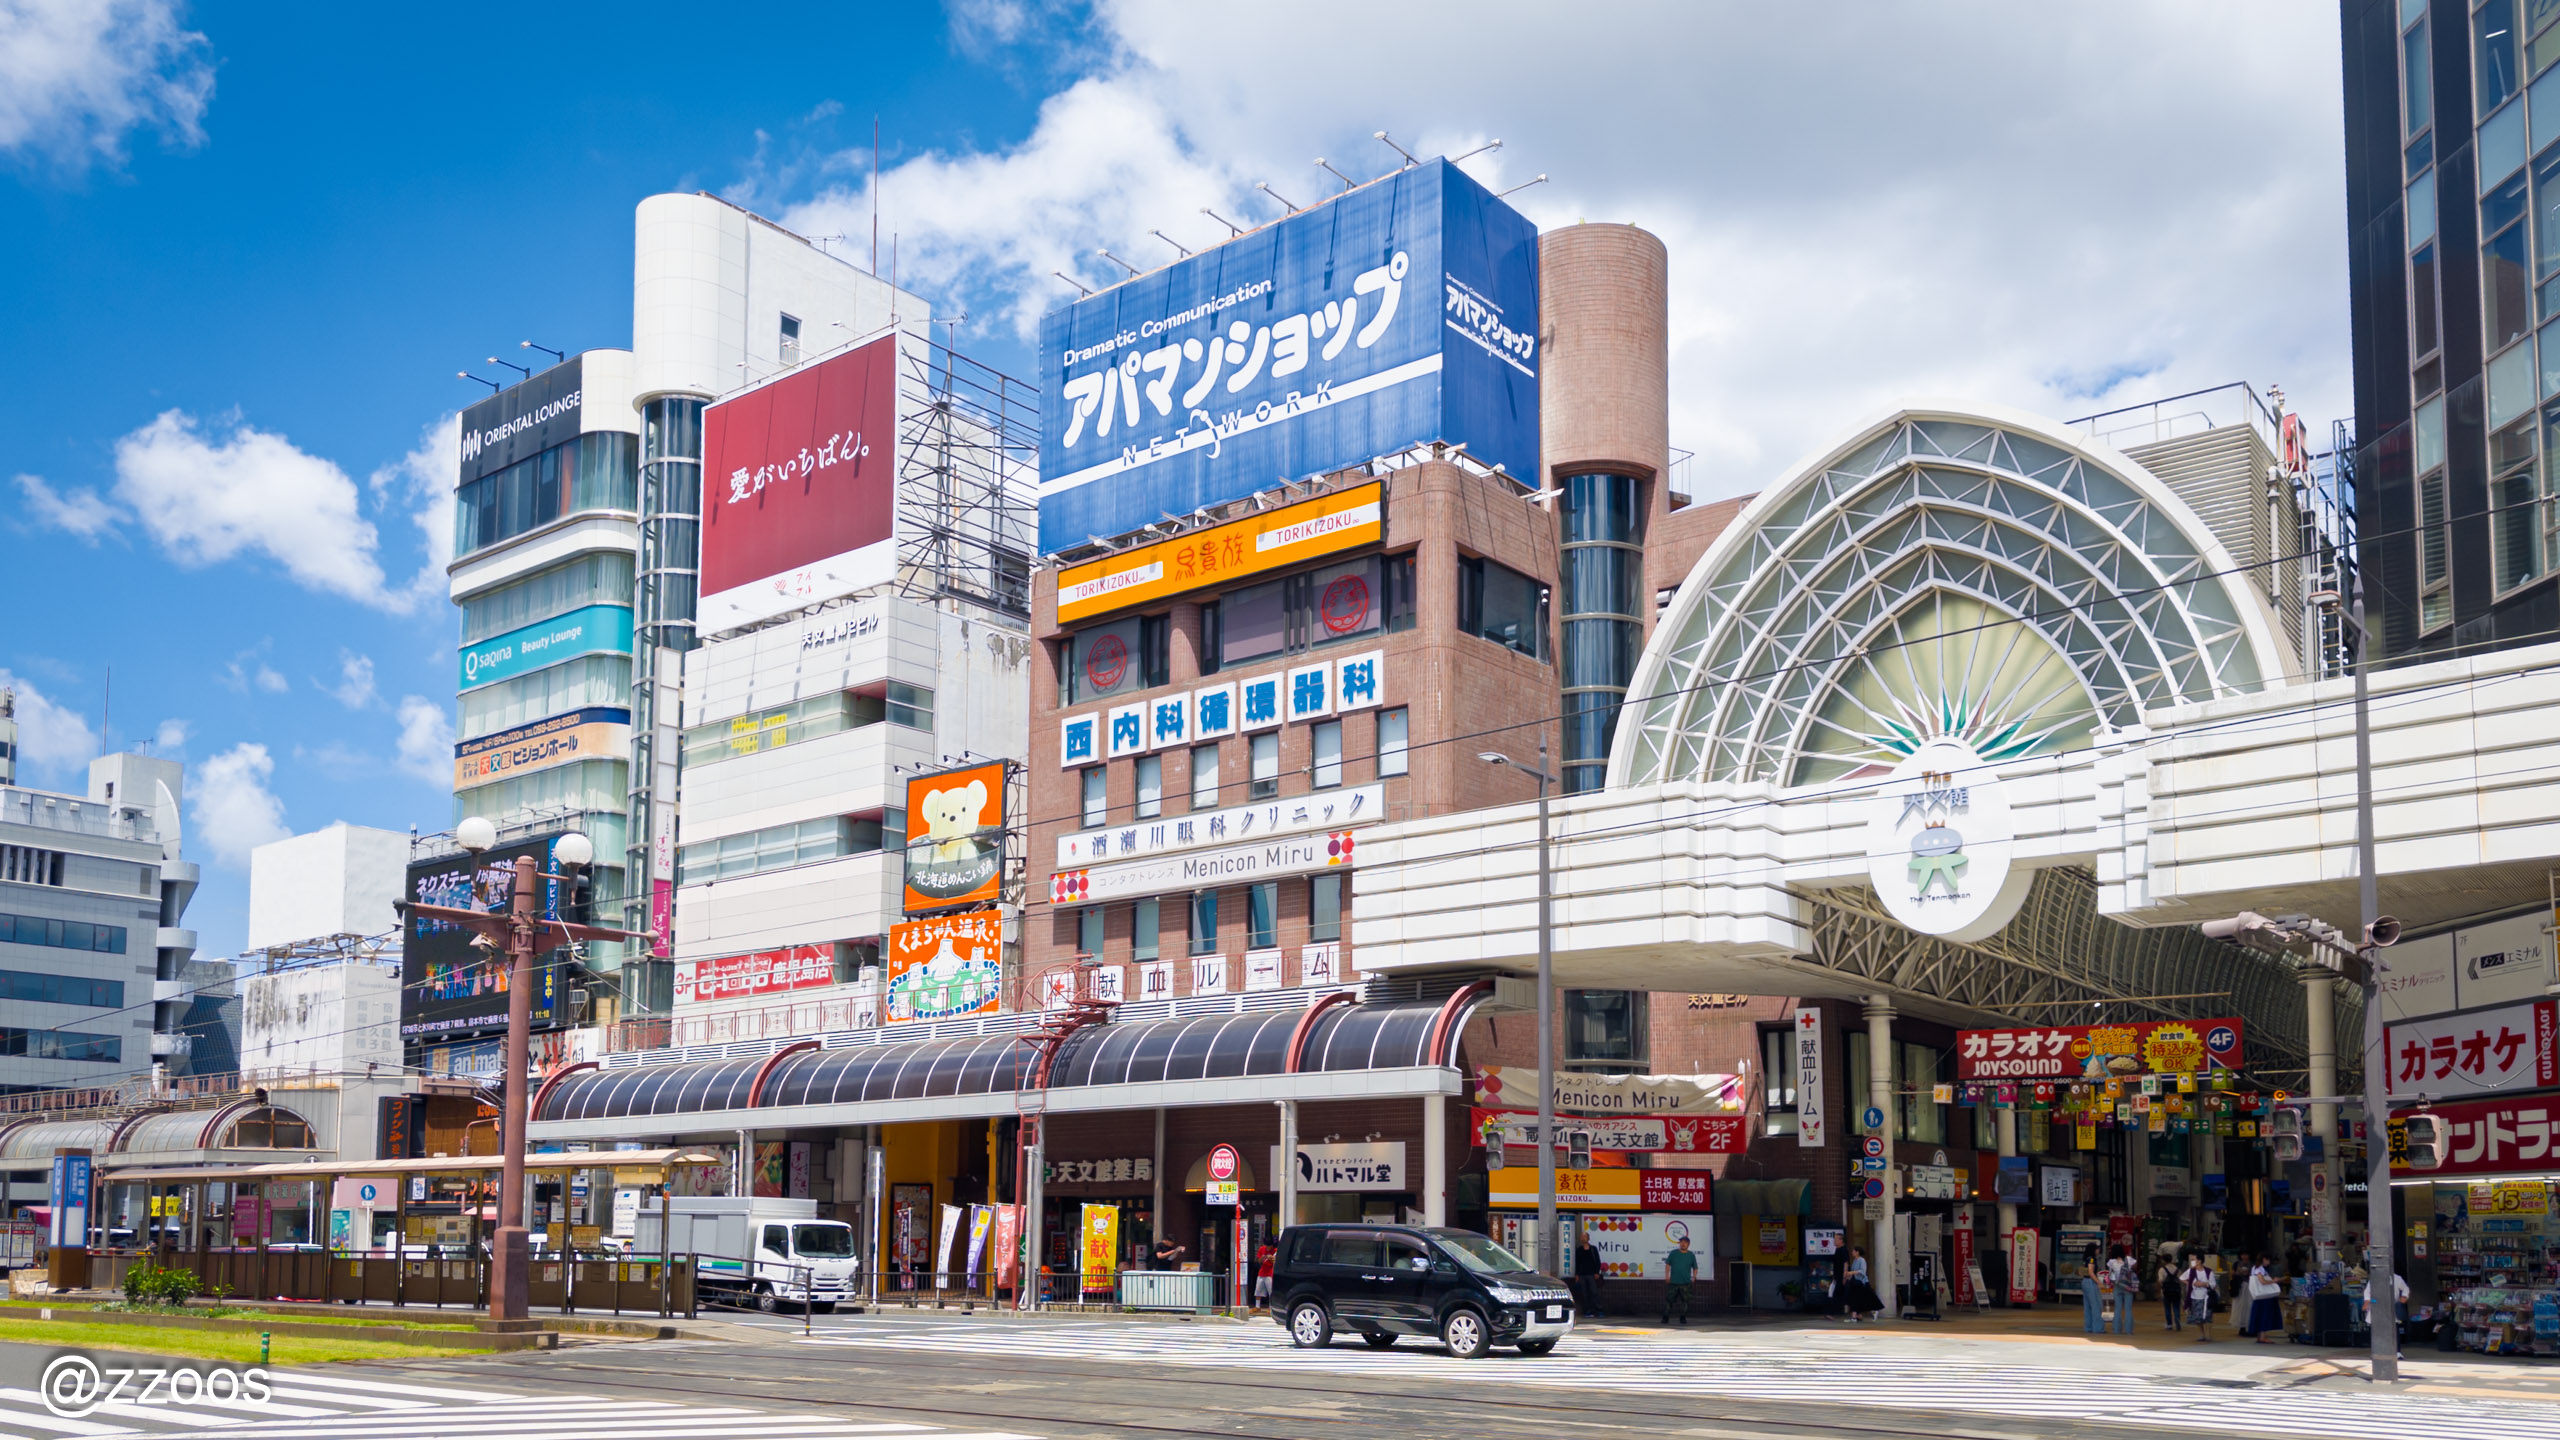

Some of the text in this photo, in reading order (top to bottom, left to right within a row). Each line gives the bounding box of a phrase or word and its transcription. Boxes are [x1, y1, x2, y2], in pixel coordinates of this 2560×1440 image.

[1063, 279, 1273, 367] Dramatic Communication
[1445, 284, 1535, 360] アパマンショップ
[1062, 250, 1409, 449] アパマンショップ
[484, 390, 581, 447] ORIENTAL LOUNGE
[1122, 378, 1333, 468] NETWORK
[727, 429, 871, 505] 愛がいちばん。
[1276, 511, 1353, 545] TORIKIZOKU
[1075, 571, 1139, 599] TORIKIZOKU
[521, 625, 582, 654] Beauty Lounge
[1066, 658, 1376, 758] 西内科循環器科
[1922, 770, 1952, 784] The
[1895, 787, 1969, 828] 天文館
[1091, 792, 1365, 858] 酒瀬川眼科クリニック
[915, 861, 994, 888] 北海道めんこい鍋
[1183, 843, 1313, 880] Menicon Miru
[1099, 866, 1175, 888] コンタクトレンズ
[1910, 895, 1923, 903] The
[899, 917, 991, 954] くまちゃん温泉
[772, 956, 830, 984] 鹿児島店
[1963, 1030, 2072, 1058] カラオケ
[2151, 1043, 2198, 1057] 持込み
[2160, 1032, 2185, 1041] 飲食物
[2210, 1033, 2233, 1047] 4F
[2540, 1008, 2552, 1080] JOYSOUND
[1973, 1058, 2062, 1077] JOYSOUND
[2164, 1057, 2186, 1070] OK
[2399, 1026, 2526, 1084] カラオケ
[1801, 1039, 1818, 1116] 献血ルーム
[1633, 1091, 1680, 1109] Miru
[1703, 1120, 1726, 1131] こちら
[1710, 1133, 1731, 1150] 2F
[1058, 1159, 1153, 1182] 天文館薬局
[1316, 1164, 1391, 1183] ハトマル堂
[1317, 1157, 1374, 1165] まちかどサンドイッチ
[1558, 1173, 1588, 1191] 貴族
[1644, 1177, 1706, 1190] 土日祝 昼営業
[2493, 1190, 2521, 1211] 15
[1599, 1241, 1630, 1252] Miru
[1089, 1238, 1110, 1284] 献血
